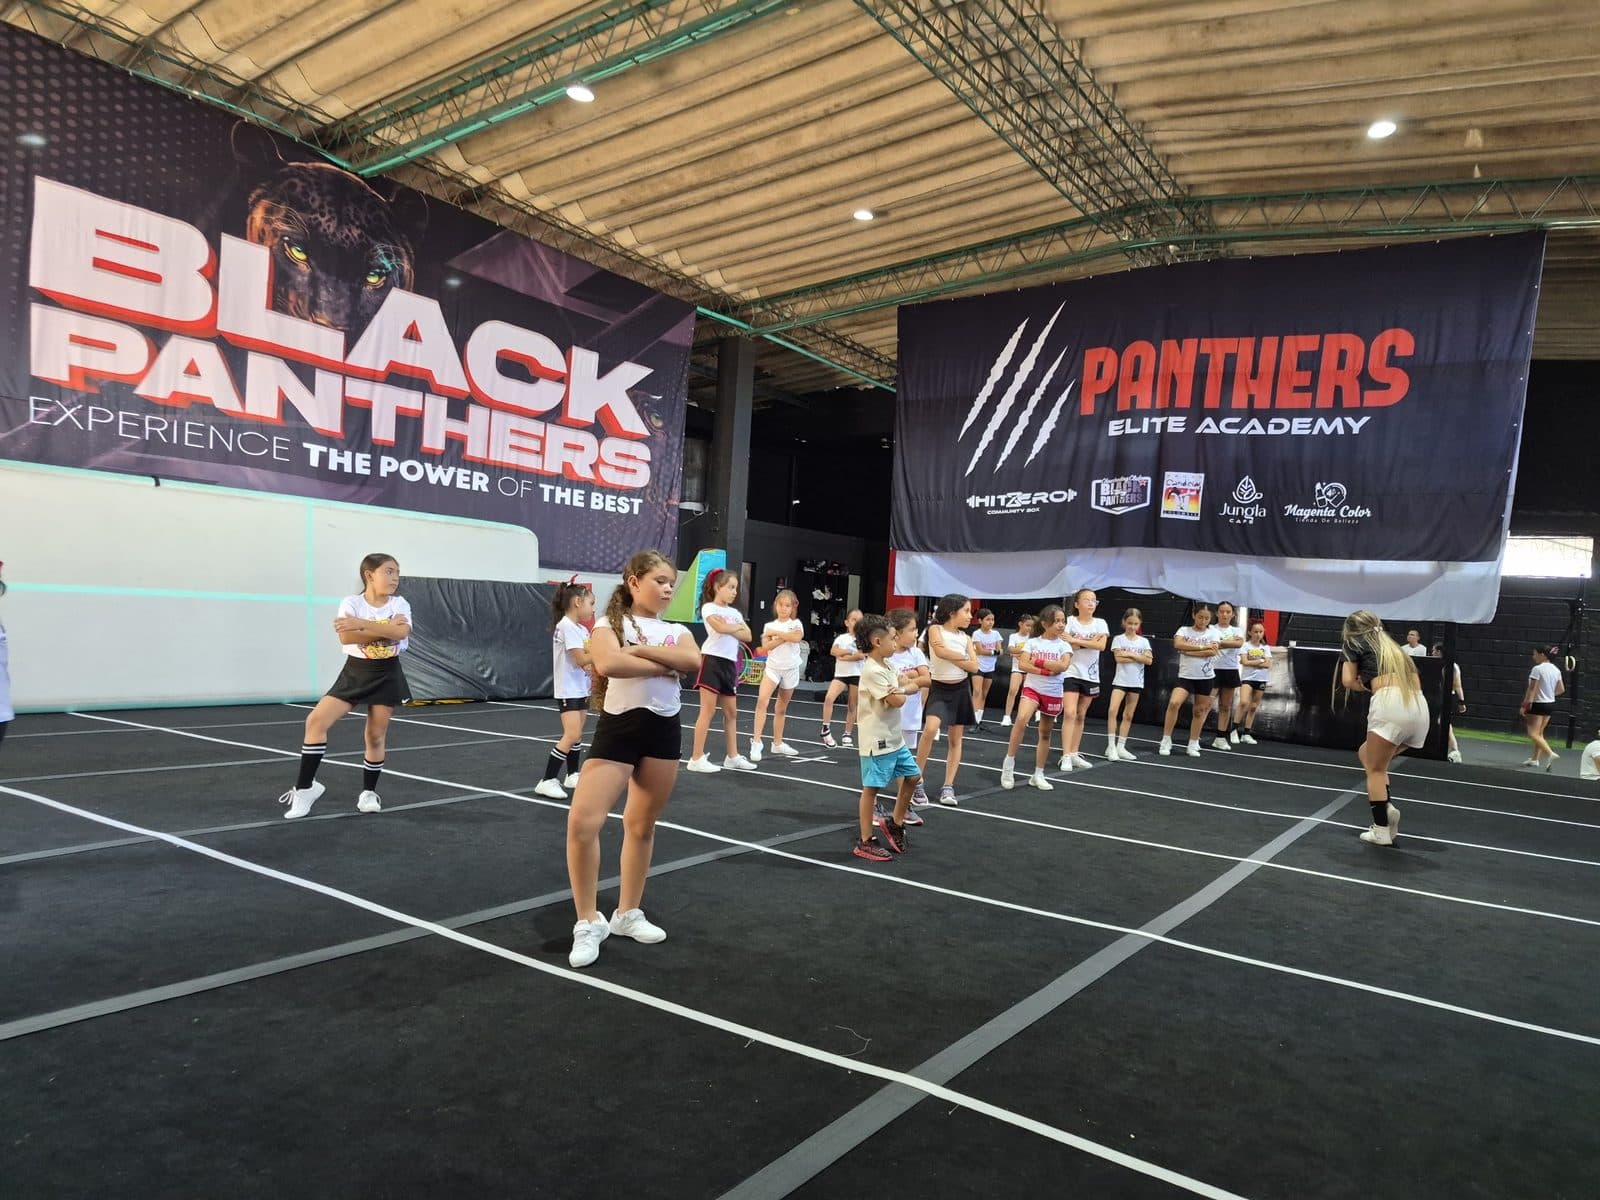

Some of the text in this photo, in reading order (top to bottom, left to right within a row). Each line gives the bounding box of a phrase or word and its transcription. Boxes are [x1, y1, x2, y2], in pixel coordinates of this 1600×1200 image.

[30, 175, 654, 441] BLACK
[30, 302, 651, 490] PANTHERS
[1080, 328, 1416, 416] PANTHERS
[1108, 415, 1372, 437] ELITE ACADEMY
[29, 396, 643, 515] EXPERIENCE THE POWER OF THE BEST
[1100, 480, 1142, 496] BLACK
[1218, 502, 1267, 521] Jungla
[1284, 504, 1372, 520] Magenta Color
